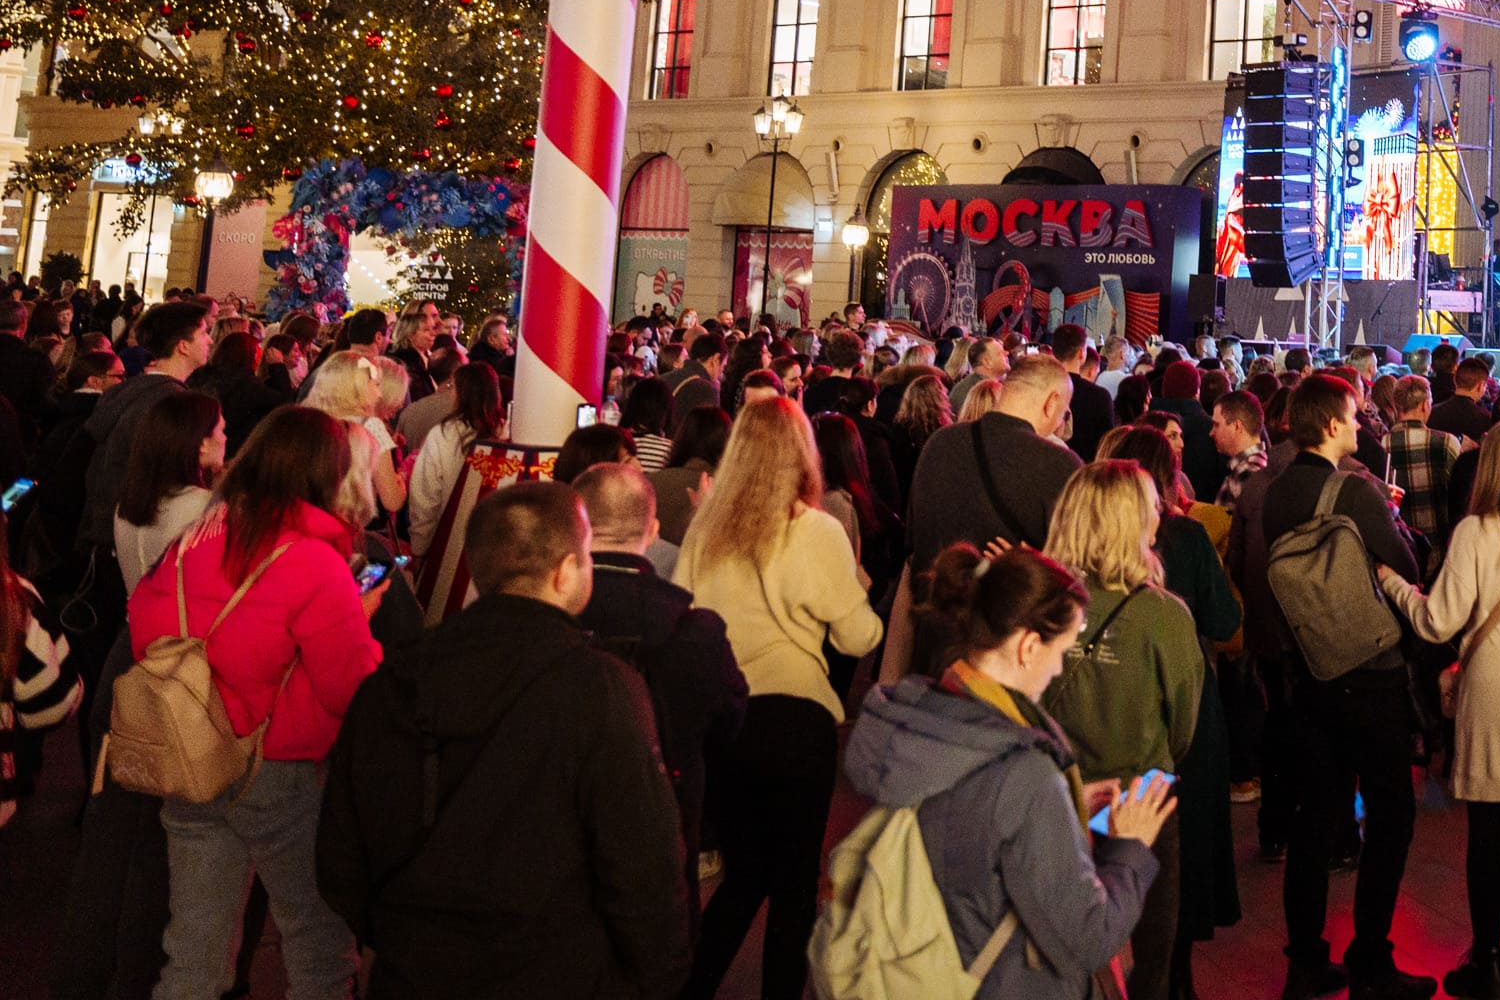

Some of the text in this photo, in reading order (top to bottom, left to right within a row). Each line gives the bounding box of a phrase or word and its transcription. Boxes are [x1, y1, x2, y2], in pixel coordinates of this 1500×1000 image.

[917, 199, 1153, 248] МОСКВА
[218, 231, 256, 244] СКОРО
[633, 248, 685, 261] ОТКРЫТИЕ
[1084, 253, 1156, 265] ЭТО ЛЮБОВЬ
